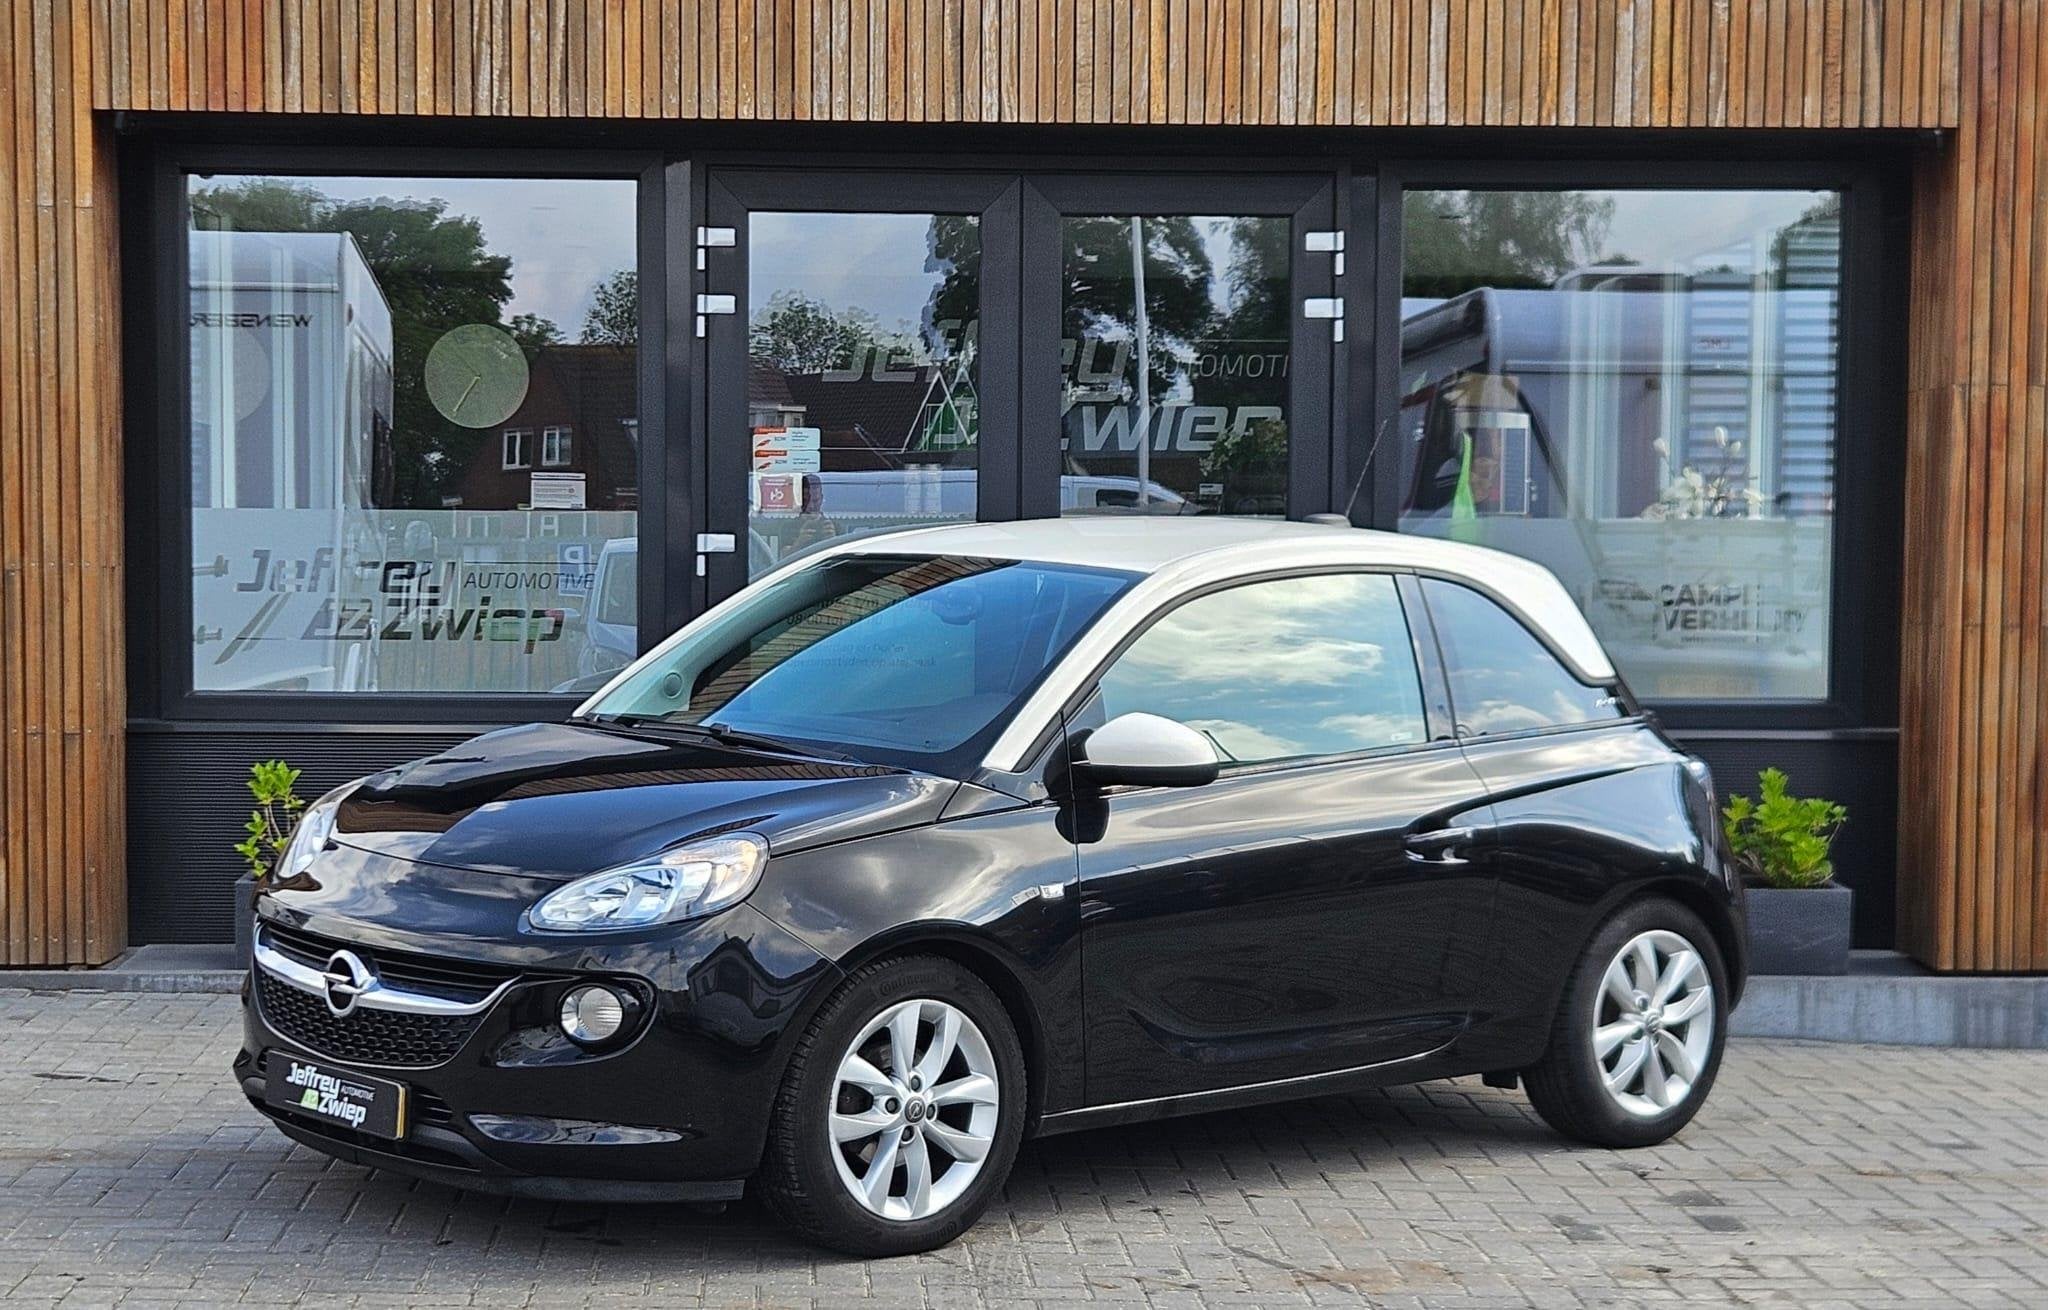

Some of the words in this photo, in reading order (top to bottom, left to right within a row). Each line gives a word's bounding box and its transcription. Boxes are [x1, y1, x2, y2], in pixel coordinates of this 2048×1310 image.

[463, 571, 595, 590] AUTOMOTIVE
[286, 1062, 341, 1100] Jeffrey
[317, 1092, 367, 1128] Zwiep
